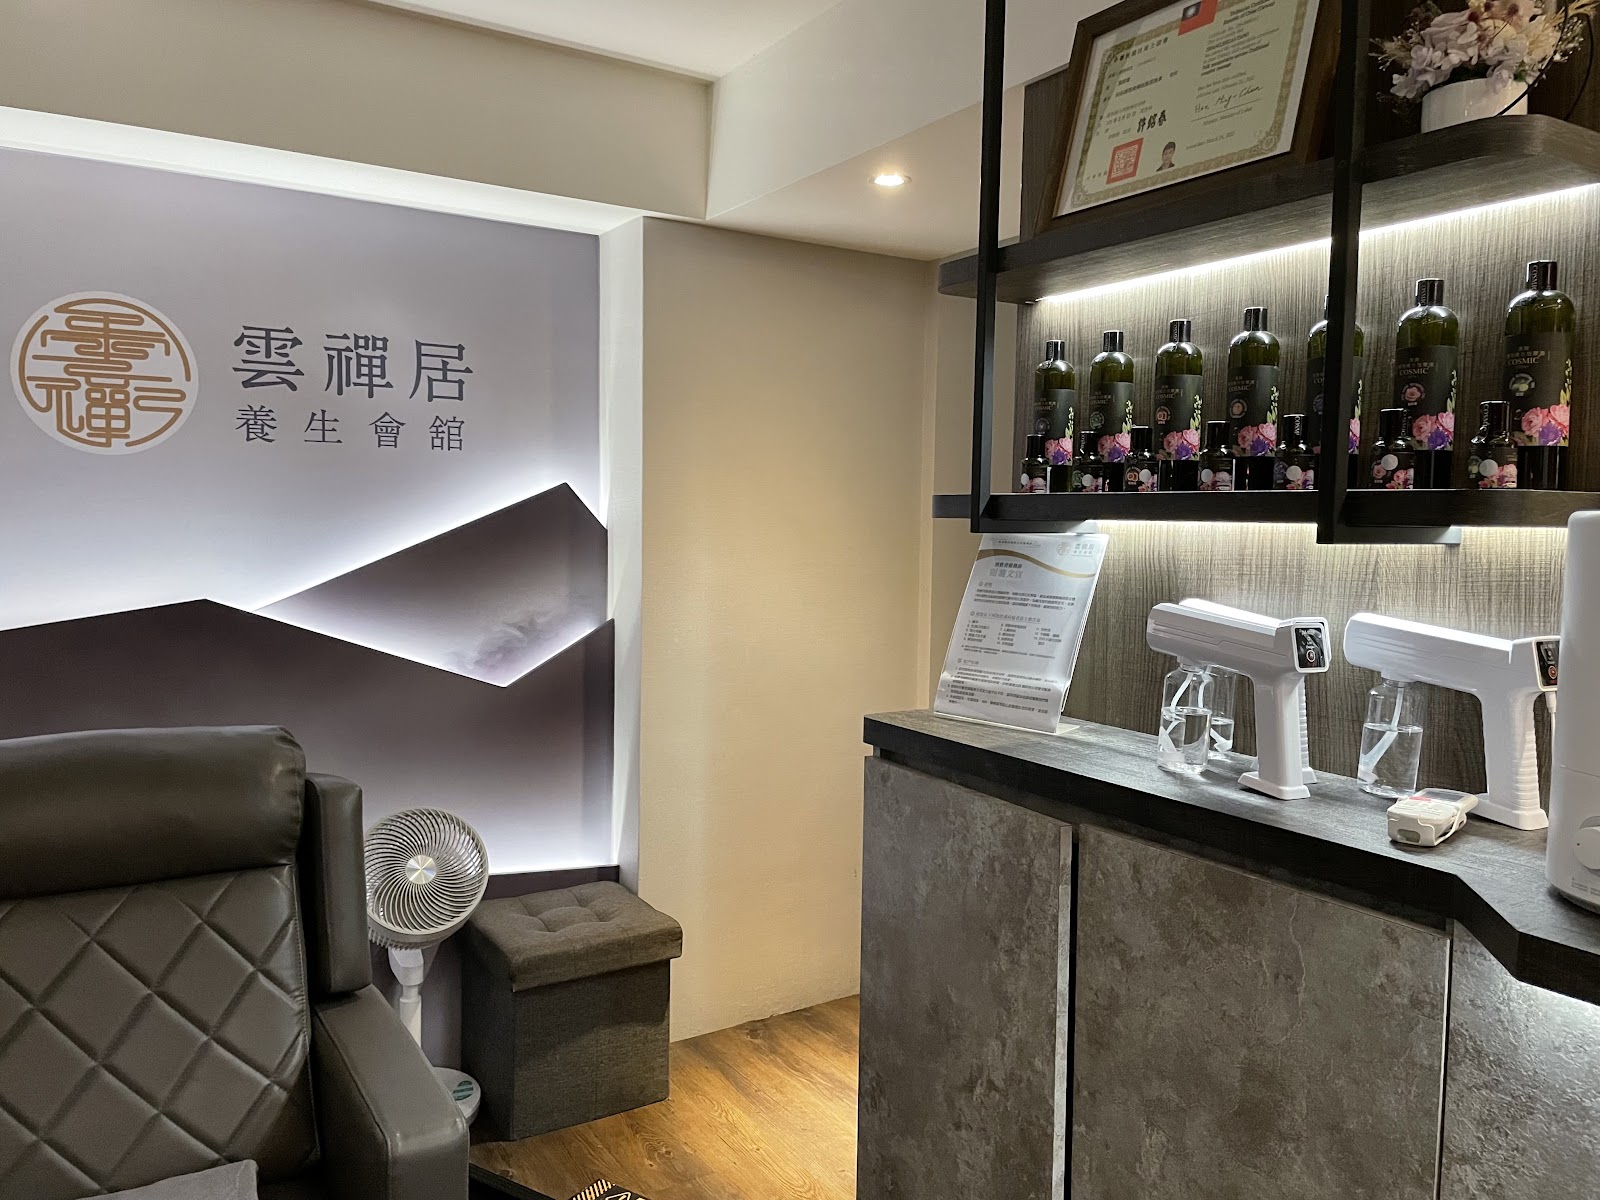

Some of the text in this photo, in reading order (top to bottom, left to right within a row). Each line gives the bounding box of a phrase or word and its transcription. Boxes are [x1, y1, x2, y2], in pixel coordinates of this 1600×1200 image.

[231, 324, 475, 403] 雲禪居
[1508, 356, 1540, 366] COSMIC
[1399, 367, 1429, 376] COSMIC
